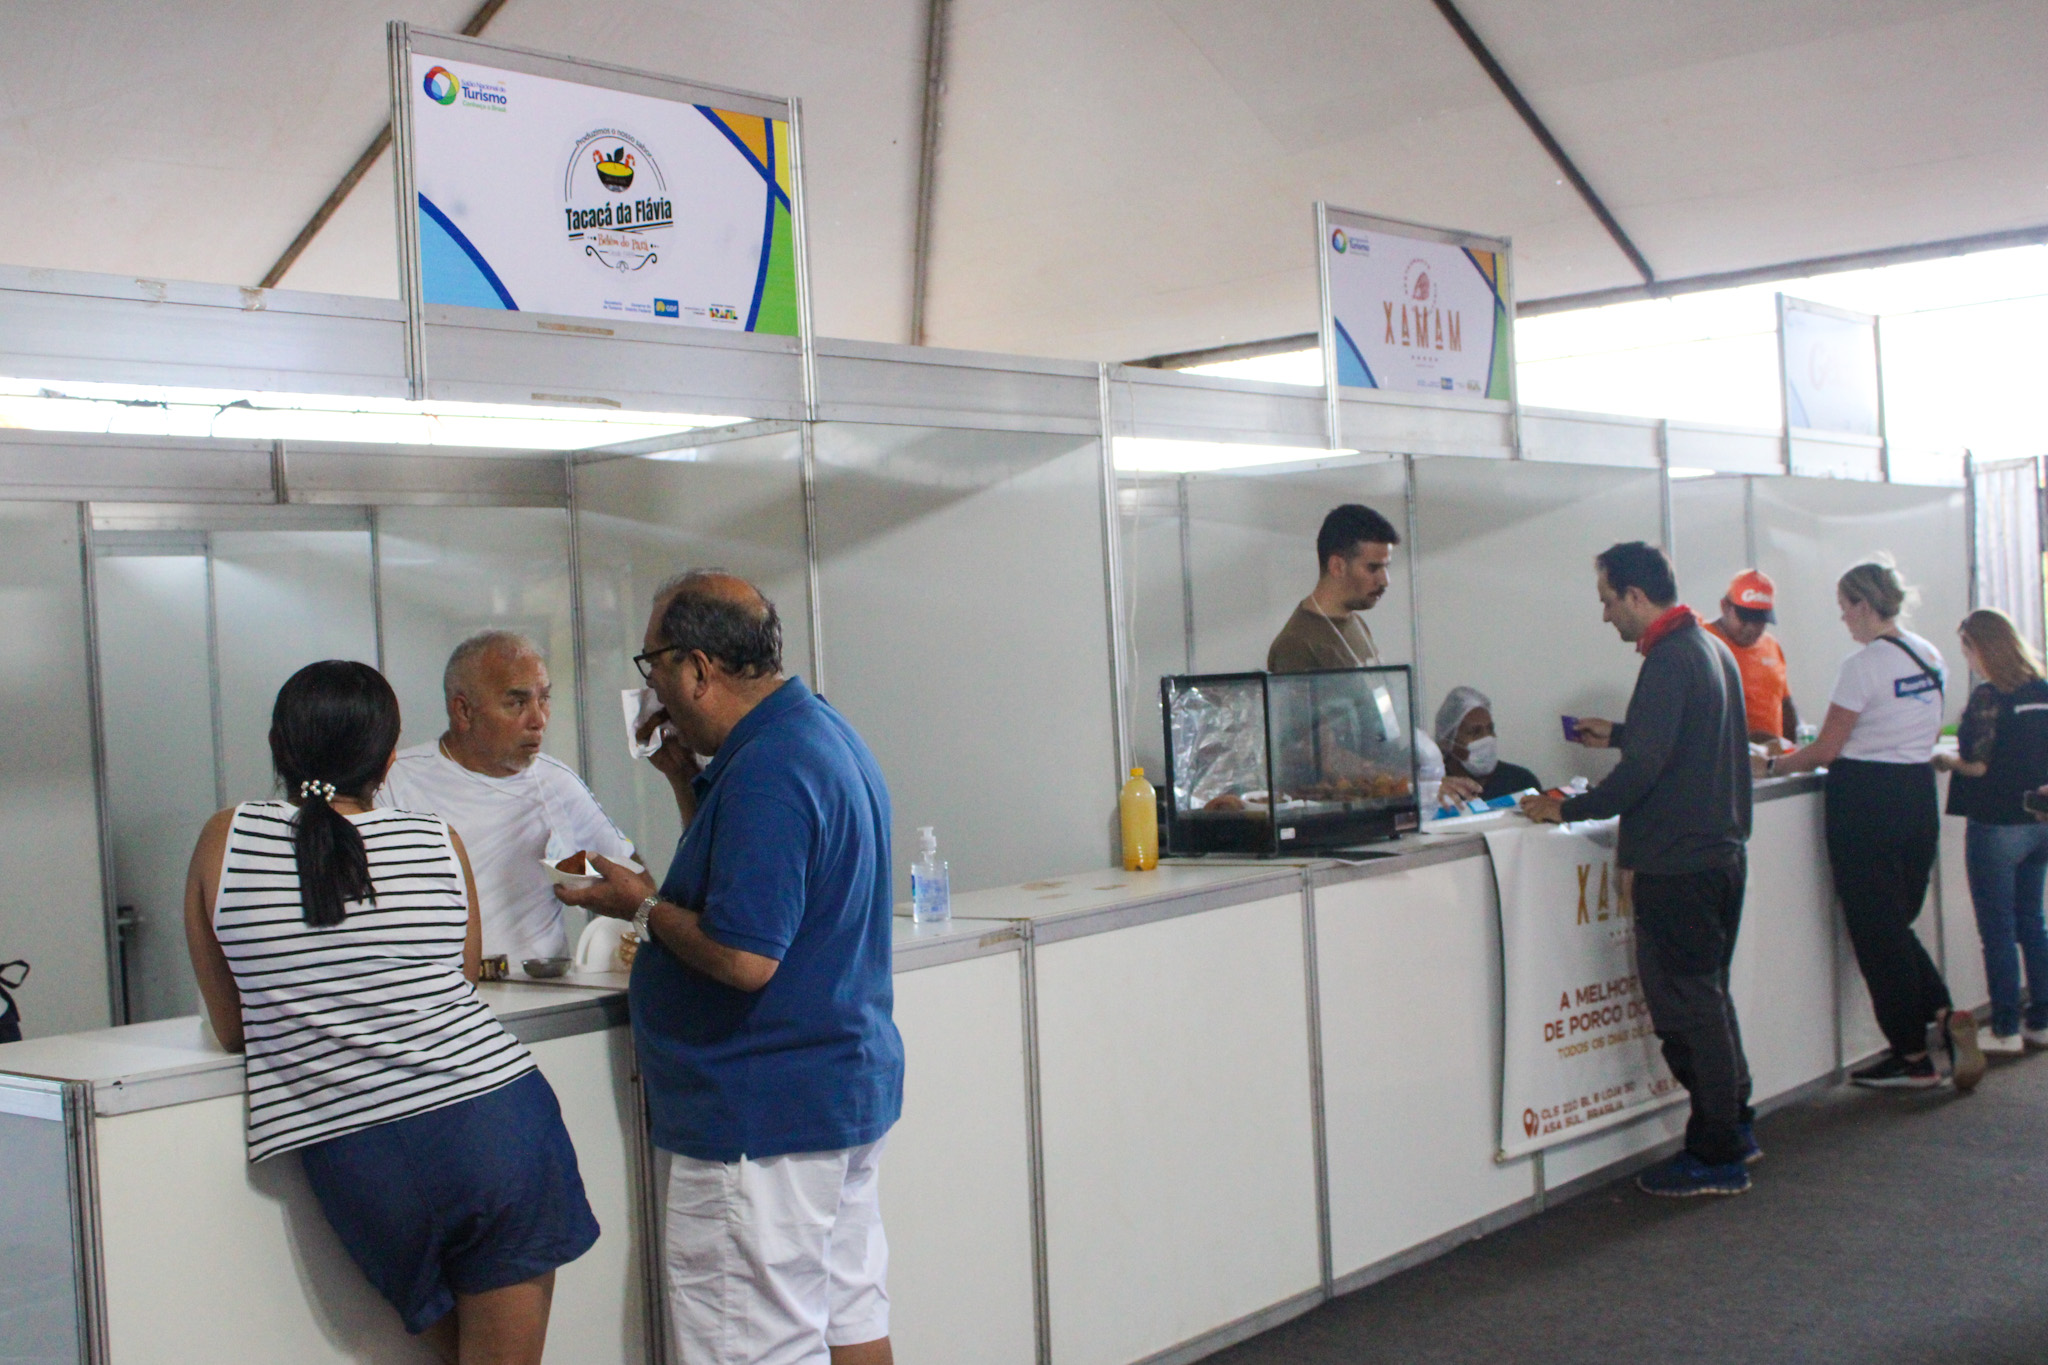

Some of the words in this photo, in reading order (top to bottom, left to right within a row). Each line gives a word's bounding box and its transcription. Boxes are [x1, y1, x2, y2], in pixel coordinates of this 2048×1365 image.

[461, 86, 507, 105] Turismo
[575, 127, 611, 148] Produzimos
[617, 129, 636, 144] nosso
[565, 201, 613, 231] Tacacá
[616, 202, 632, 225] da
[635, 197, 673, 223] Flávia
[1383, 301, 1462, 353] XAMAM
[1559, 991, 1571, 1012] A
[1576, 975, 1637, 1007] MELHOR
[1544, 1019, 1566, 1043] DE
[1569, 1004, 1623, 1035] PORCO
[1543, 1120, 1562, 1136] ASA
